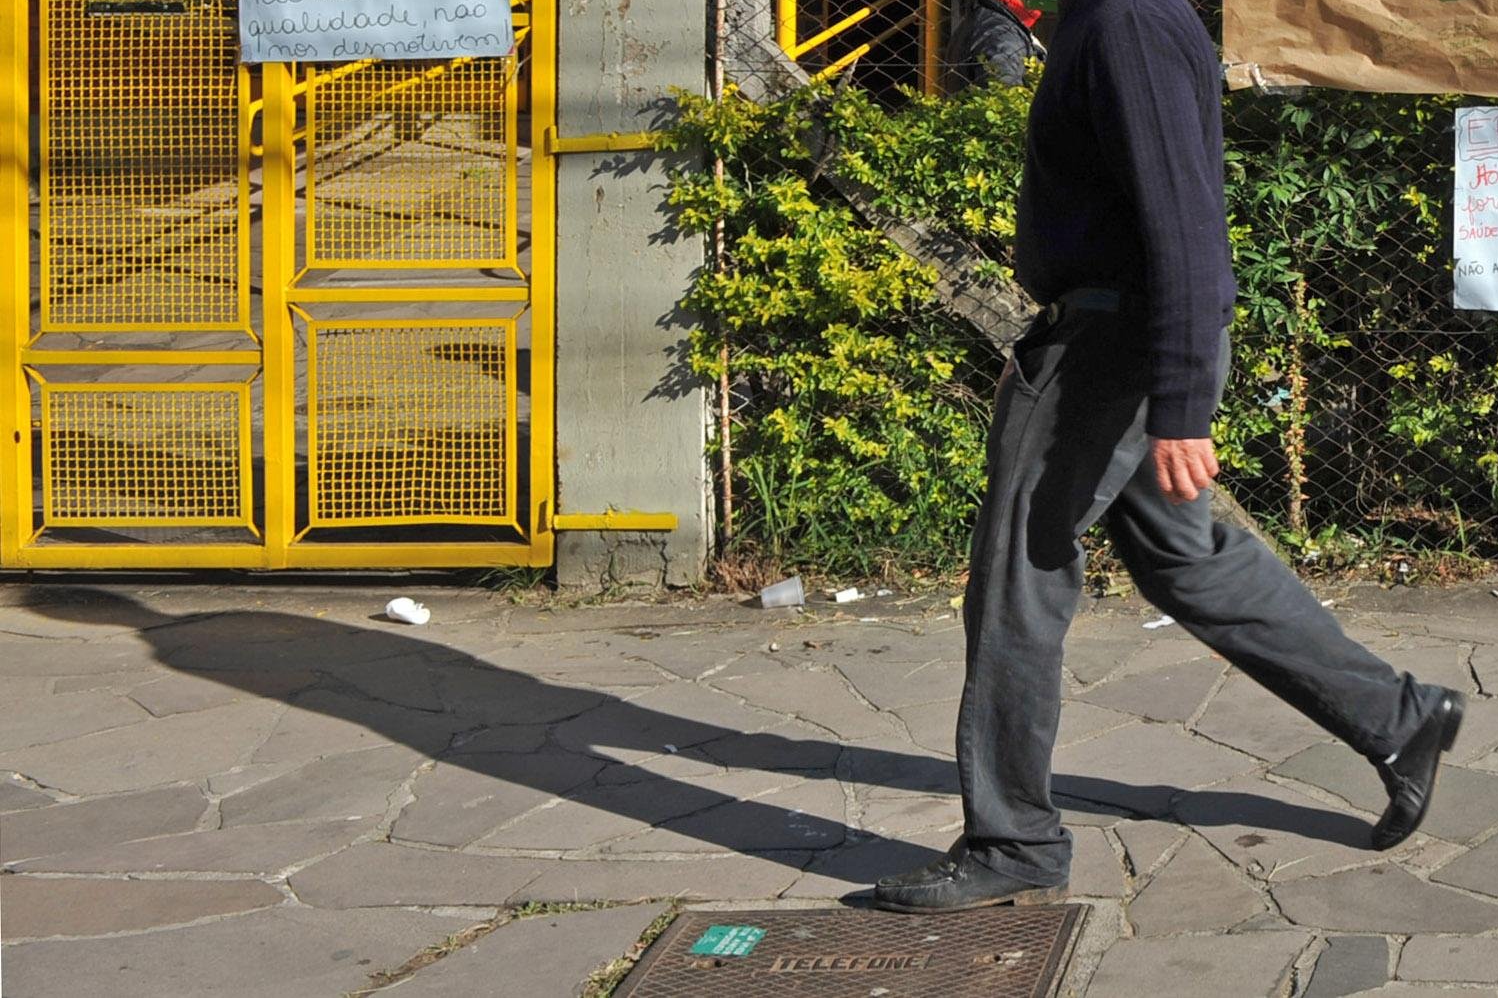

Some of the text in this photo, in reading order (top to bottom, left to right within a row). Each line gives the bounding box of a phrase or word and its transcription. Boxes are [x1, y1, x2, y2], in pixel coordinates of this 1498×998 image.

[249, 4, 427, 52] qualidade,
[268, 43, 318, 58] nos
[1459, 222, 1498, 241] SAÚDE
[1458, 260, 1484, 277] NÃO
[779, 955, 922, 971] TELEFONE
